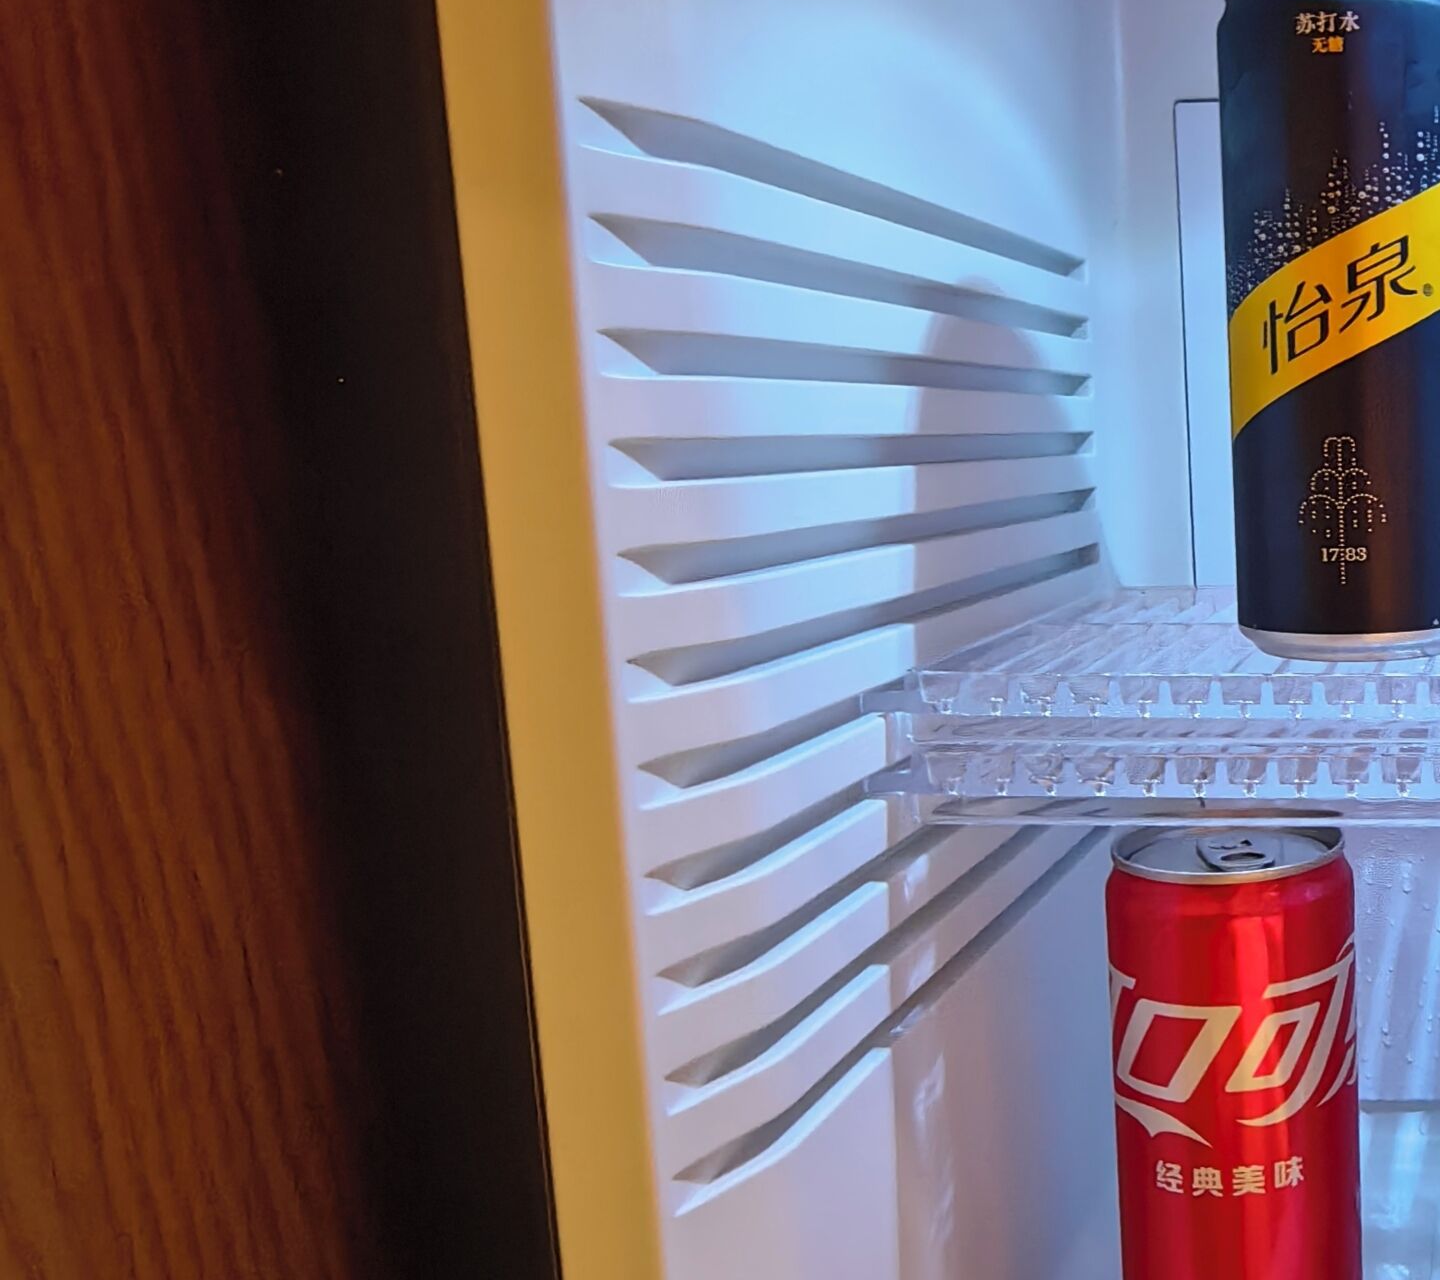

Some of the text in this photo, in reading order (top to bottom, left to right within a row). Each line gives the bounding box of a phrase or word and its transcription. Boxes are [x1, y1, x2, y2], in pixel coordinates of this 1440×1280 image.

[1295, 11, 1360, 35] 苏打水
[1263, 235, 1418, 375] 怡泉
[1321, 547, 1368, 562] 1783
[1156, 1156, 1305, 1197] 经典美味
